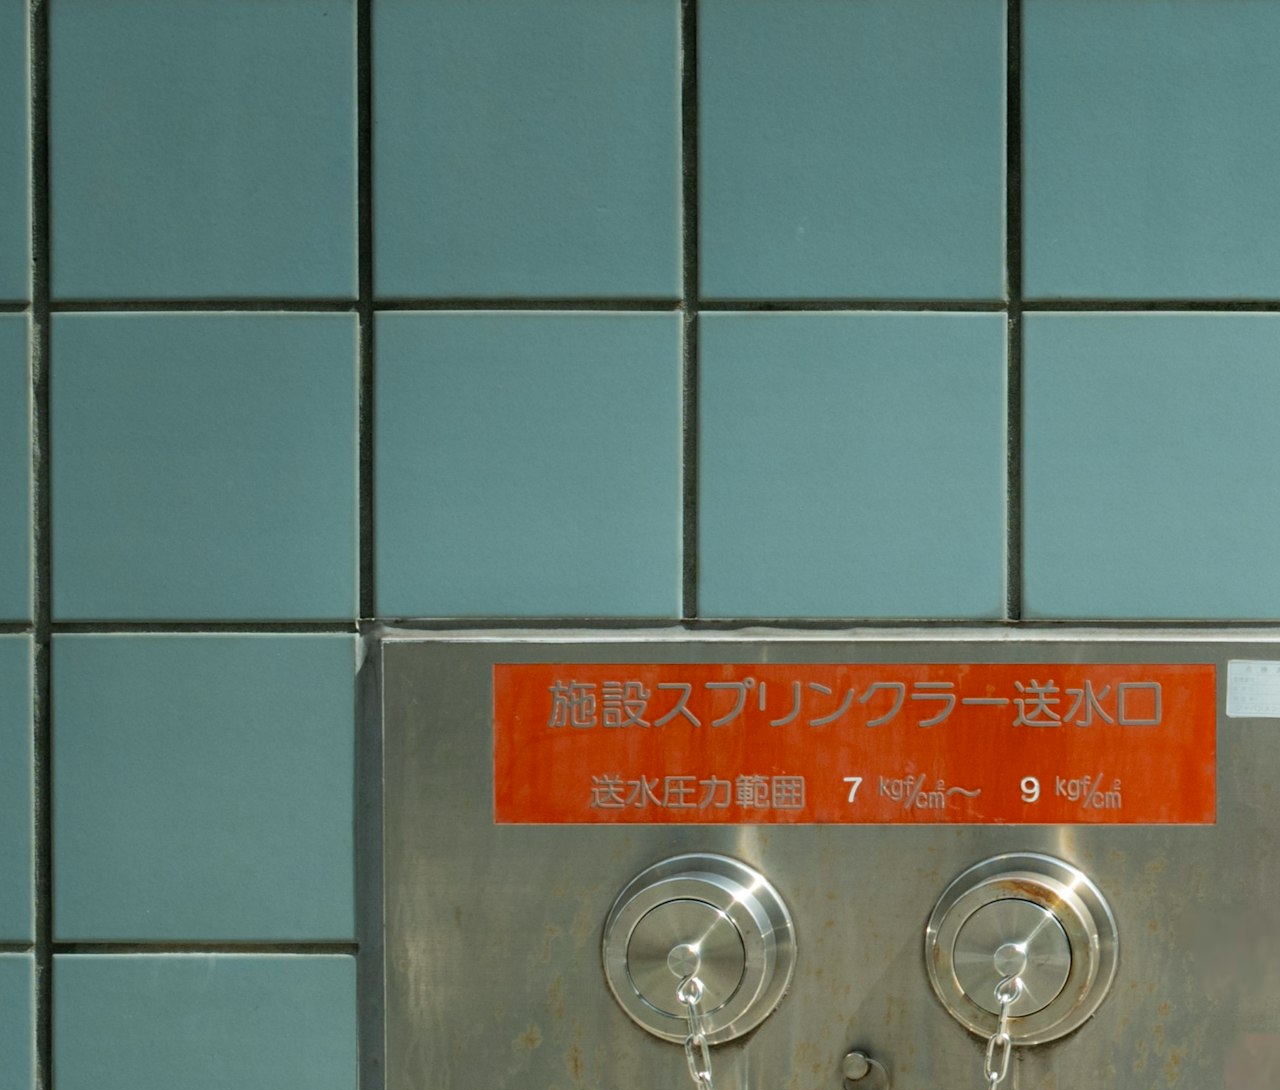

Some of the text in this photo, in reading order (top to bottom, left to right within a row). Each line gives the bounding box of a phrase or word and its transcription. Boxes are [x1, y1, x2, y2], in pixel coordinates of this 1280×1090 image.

[547, 677, 1162, 728] 施設スプリンクラー送水口
[590, 774, 805, 810] 送水圧力範囲
[843, 777, 862, 803] 7
[1020, 777, 1040, 803] 9
